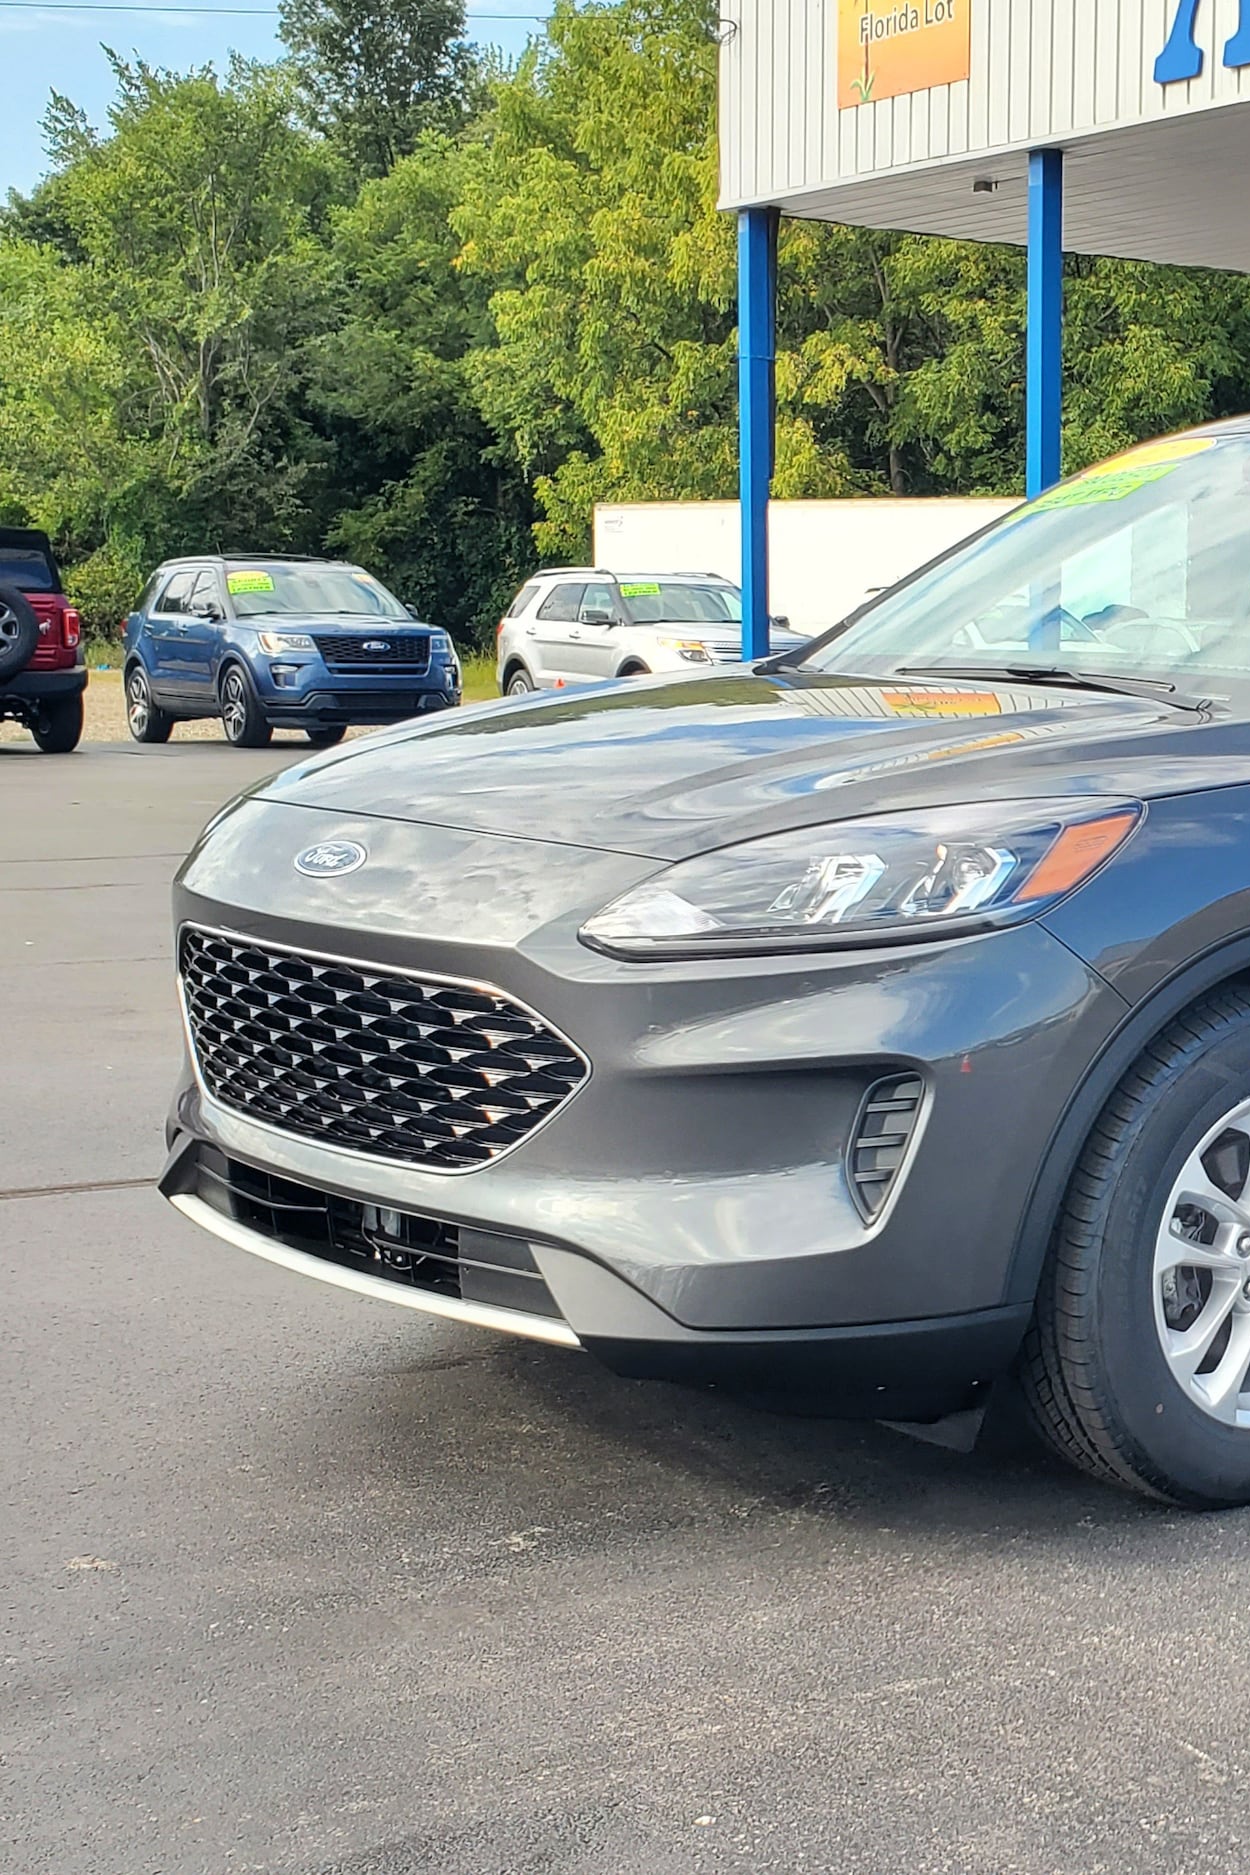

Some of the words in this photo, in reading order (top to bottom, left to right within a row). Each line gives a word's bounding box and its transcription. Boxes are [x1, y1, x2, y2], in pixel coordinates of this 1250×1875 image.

[859, 3, 919, 43] Florida
[924, 0, 953, 25] Lot
[304, 845, 350, 868] Ford
